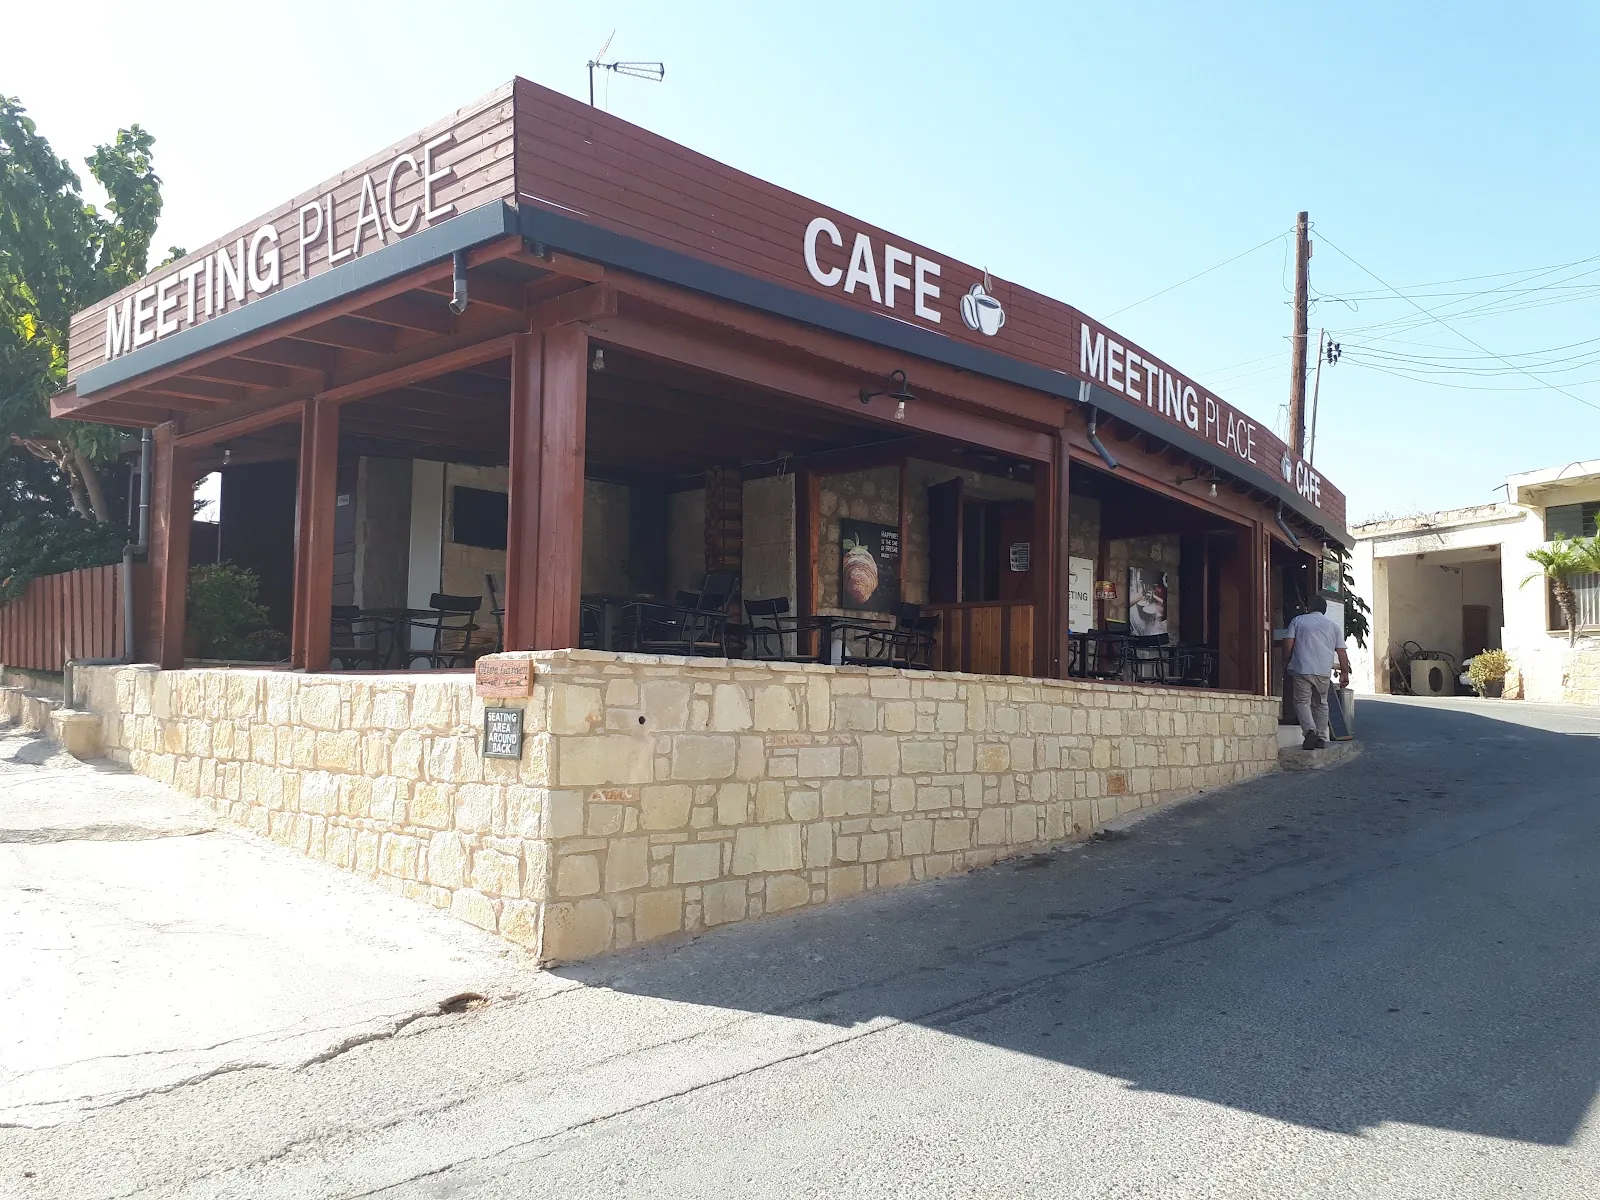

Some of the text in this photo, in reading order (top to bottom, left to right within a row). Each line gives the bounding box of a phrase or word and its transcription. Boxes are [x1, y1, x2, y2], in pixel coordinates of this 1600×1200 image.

[104, 132, 454, 360] MEETING PLACE
[803, 217, 941, 324] CAFE
[1080, 322, 1257, 464] MEETING PLACE
[1295, 460, 1321, 508] CAFE
[501, 663, 528, 675] Garden
[488, 712, 517, 722] SEATING
[492, 722, 511, 733] AREA
[488, 732, 517, 745] AROUND
[492, 743, 512, 754] BACK
